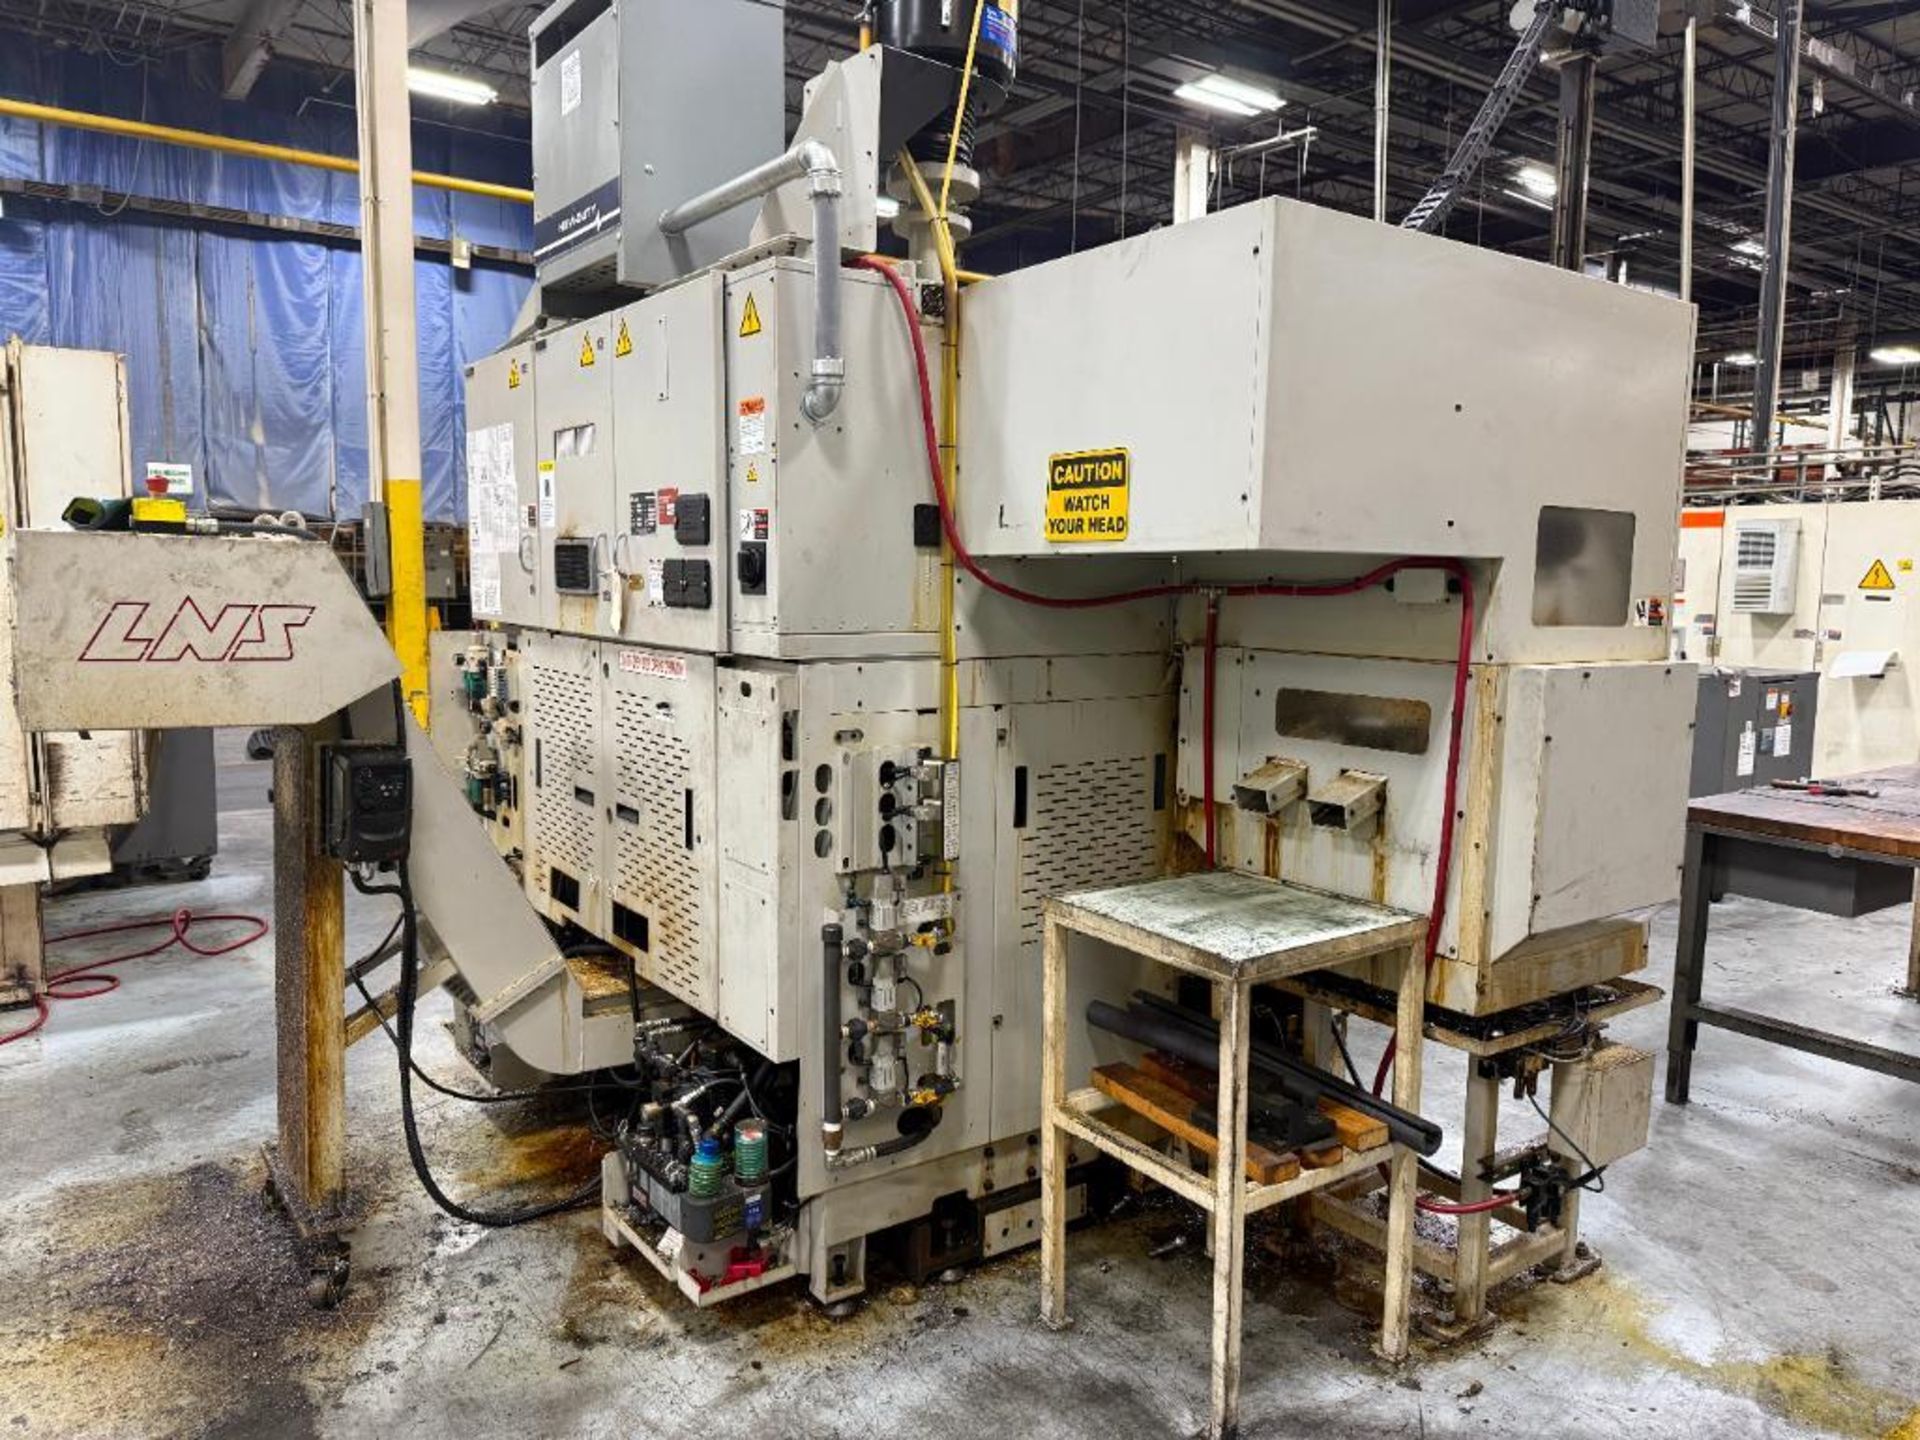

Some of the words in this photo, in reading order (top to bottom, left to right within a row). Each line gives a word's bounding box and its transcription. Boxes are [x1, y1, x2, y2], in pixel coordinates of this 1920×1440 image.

[1054, 461, 1123, 484] CAUTION
[1064, 494, 1110, 512] WATCH
[1048, 517, 1084, 534] YOUR
[1088, 516, 1125, 533] HEAD
[78, 595, 316, 662] LNS
